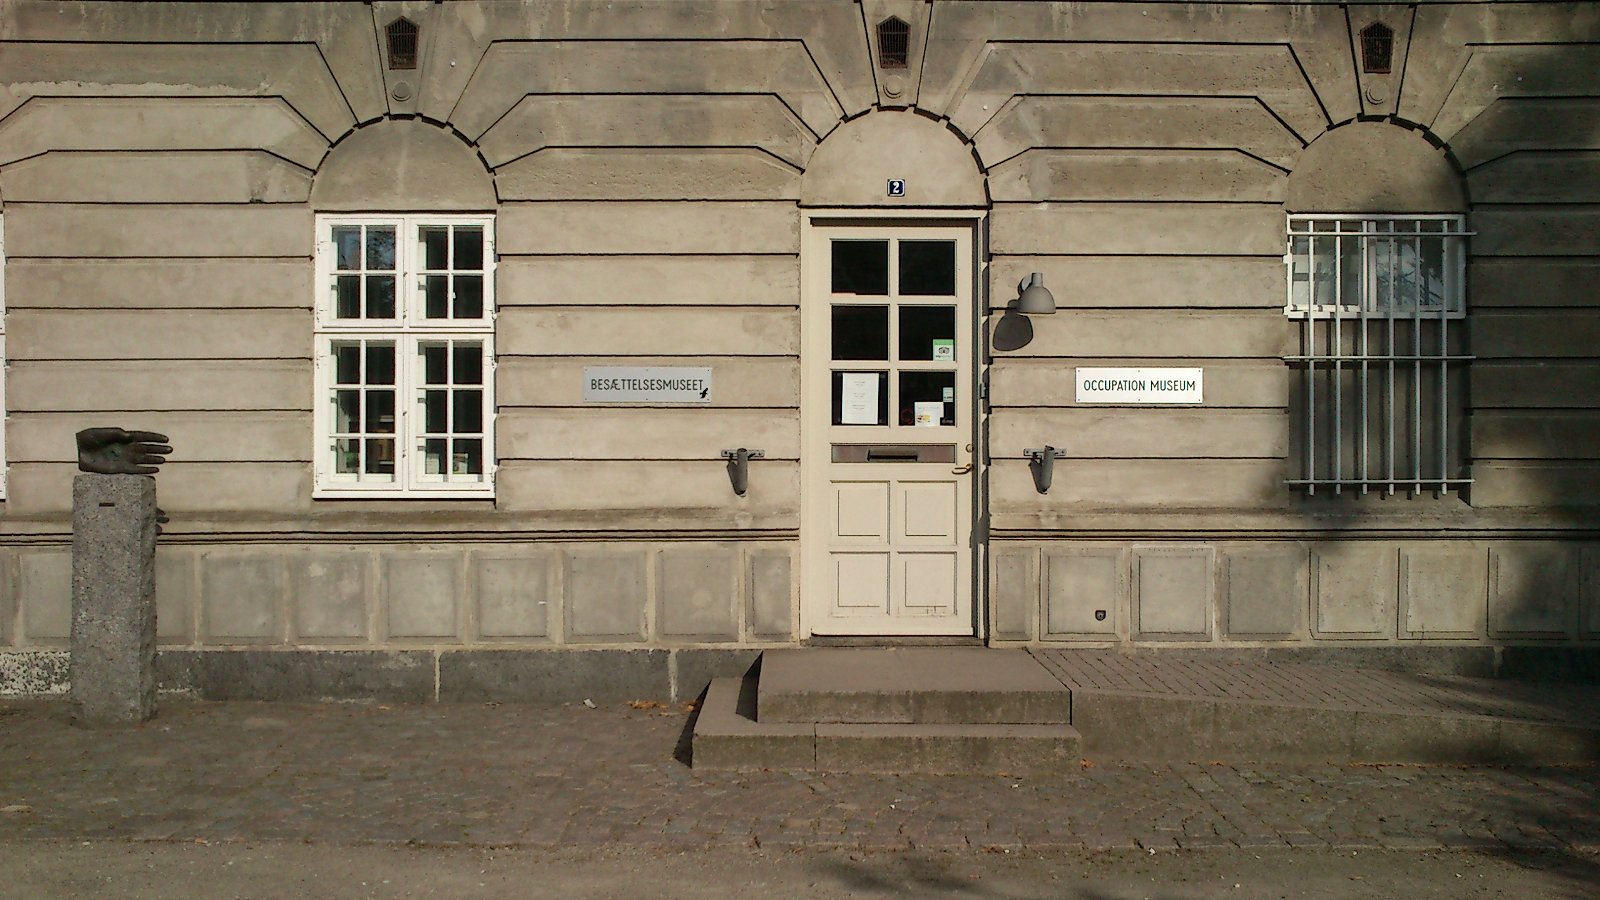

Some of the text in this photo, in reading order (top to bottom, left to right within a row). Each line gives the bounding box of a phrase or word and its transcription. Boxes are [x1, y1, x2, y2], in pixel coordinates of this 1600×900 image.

[893, 181, 900, 194] 2
[590, 379, 704, 391] BESÆTTELSESMUSEET
[1083, 379, 1196, 391] OCCUPATION MUSEUM
